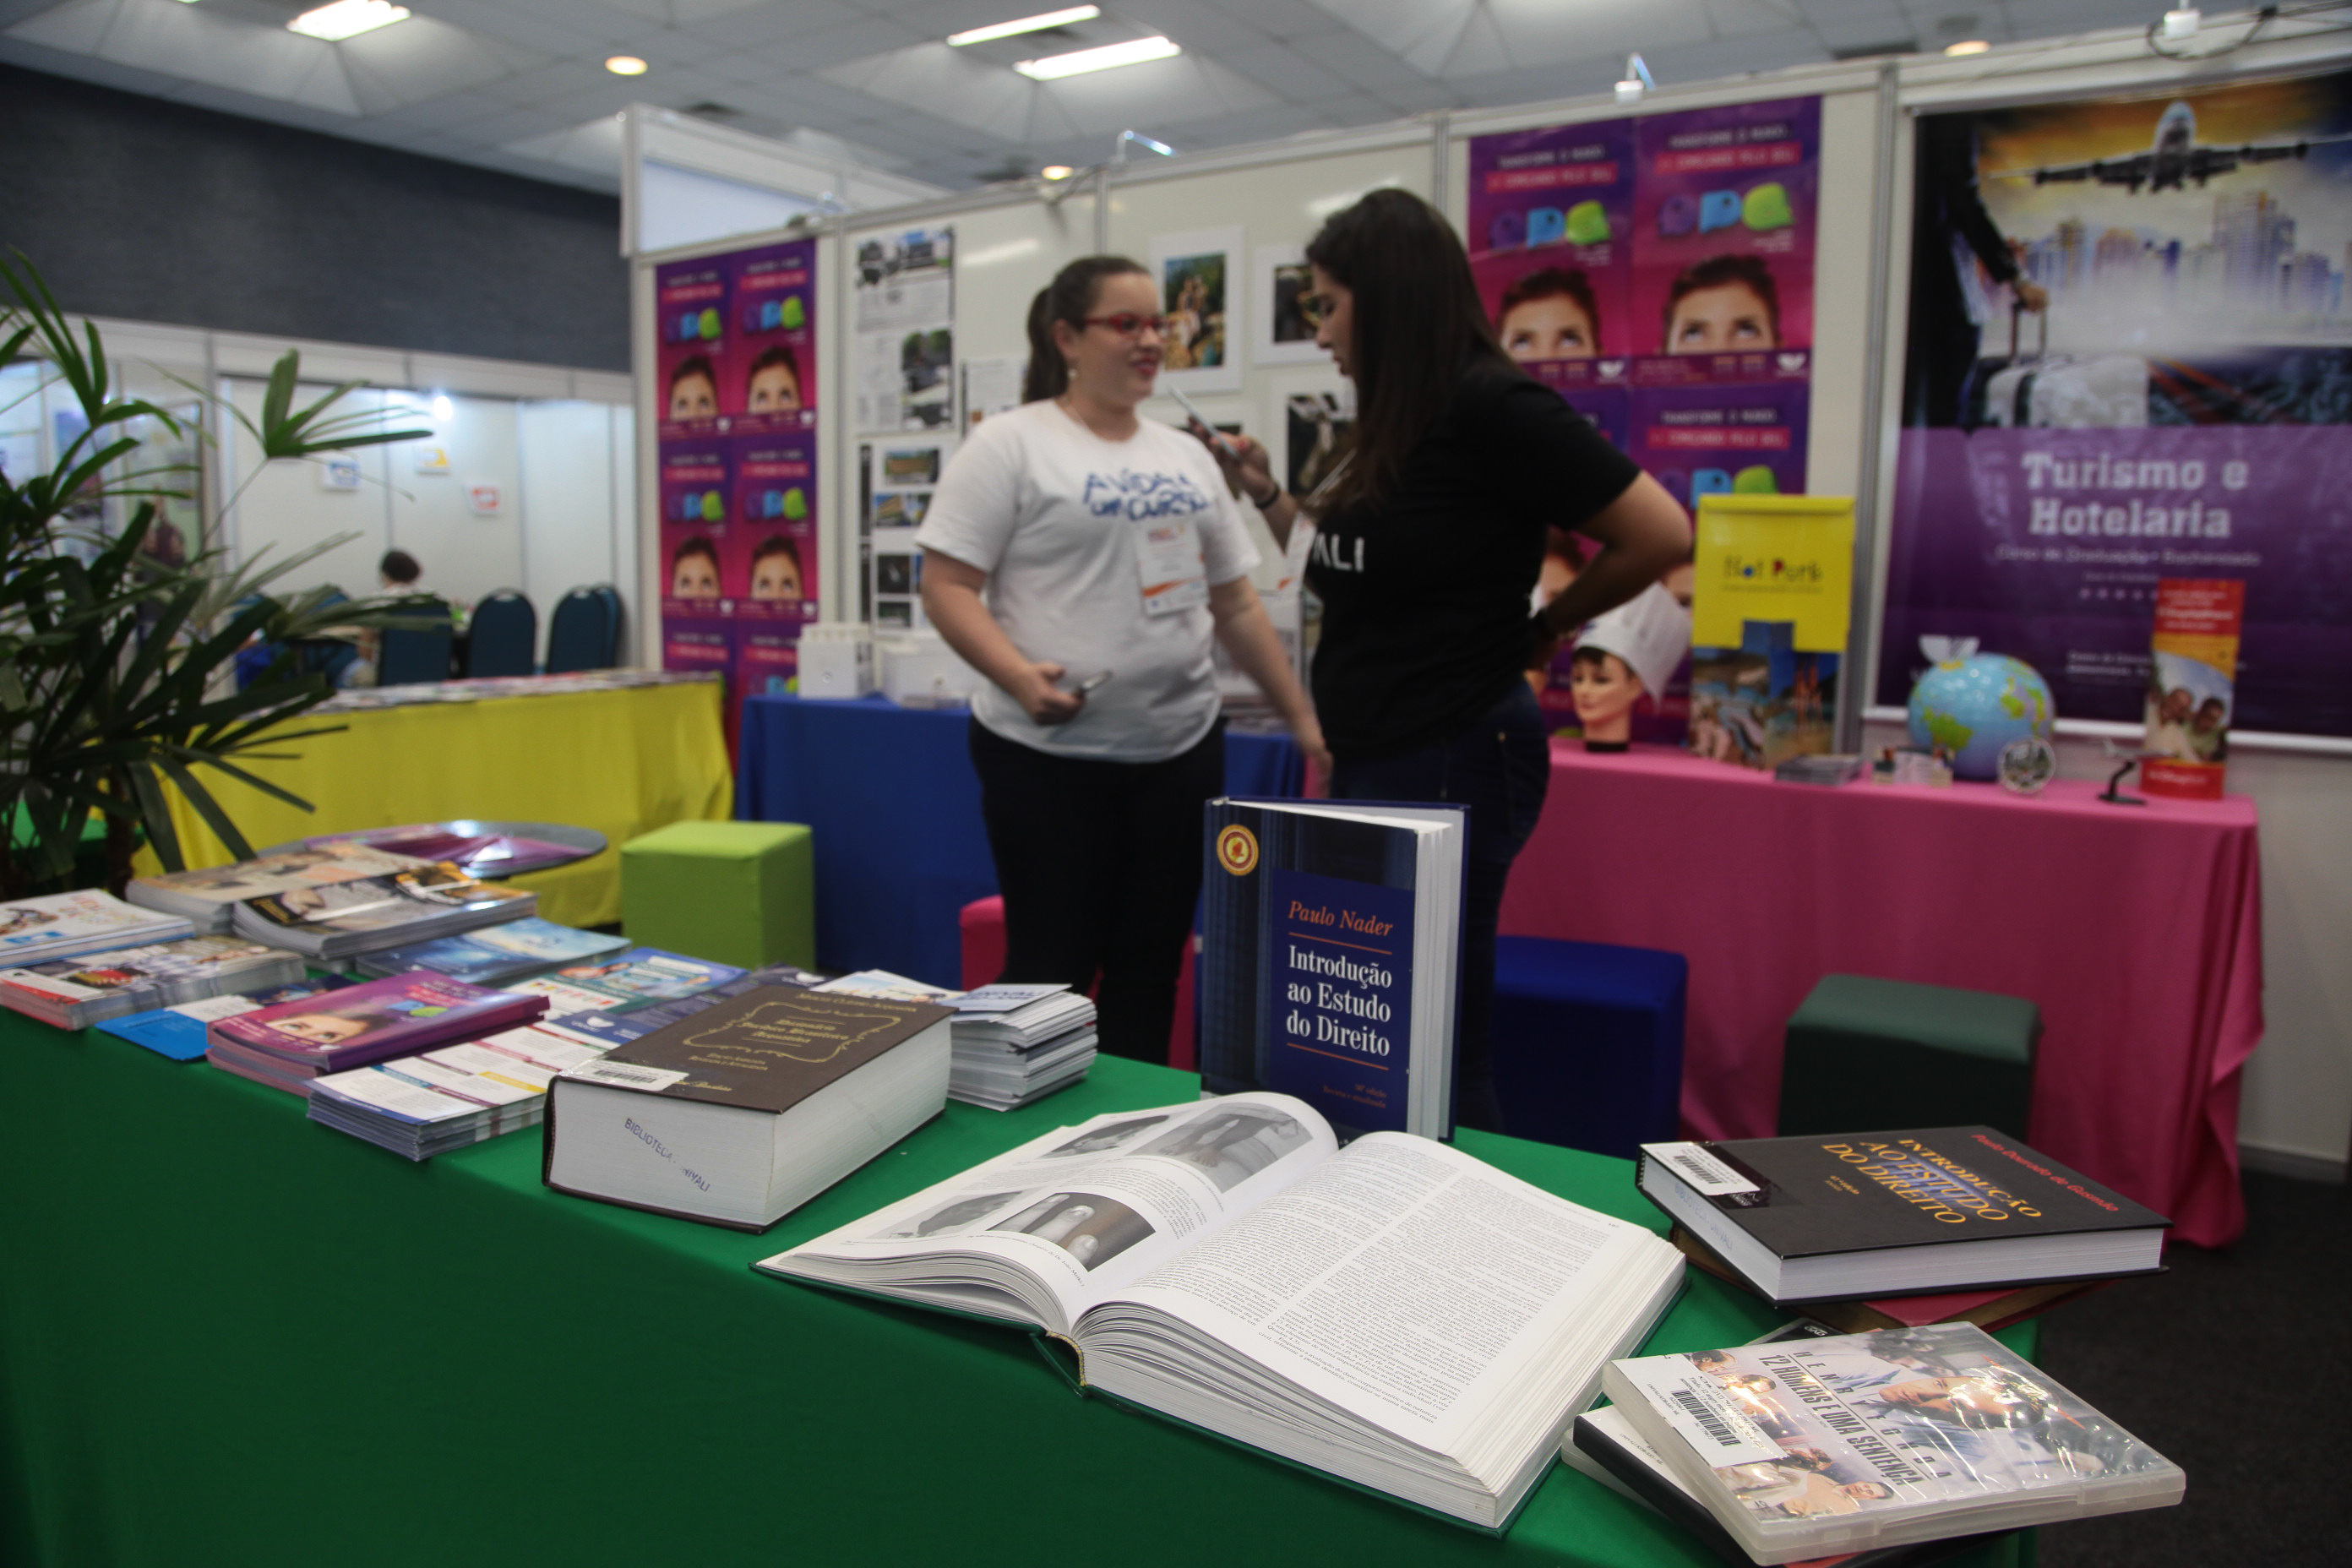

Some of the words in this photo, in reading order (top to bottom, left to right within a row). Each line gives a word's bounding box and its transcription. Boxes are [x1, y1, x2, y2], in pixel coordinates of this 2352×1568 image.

[2022, 451, 2205, 490] Turismo
[2223, 460, 2248, 489] e
[2030, 498, 2231, 538] Hotelaria
[1288, 900, 1336, 928] Paulo
[1339, 910, 1394, 937] Nader
[1288, 945, 1393, 990] Introdução
[1287, 981, 1312, 1004] ao
[1317, 982, 1391, 1023] Estudo
[1286, 1010, 1311, 1037] do
[1316, 1014, 1391, 1058] Direito
[624, 1118, 674, 1161] BIBLIOTECA
[1971, 1135, 2004, 1152] Paulo
[1821, 1144, 1869, 1163] DO
[1856, 1165, 1967, 1223] DIREITO
[1859, 1142, 1907, 1161] AO
[1897, 1163, 2009, 1221] ESTUDO
[1897, 1140, 2042, 1217] INTRODUÇÃO
[1266, 1324, 1288, 1337] Quadro
[1257, 1331, 1273, 1341] civil,
[1273, 1339, 1298, 1354] referente
[1304, 1355, 1321, 1367] perda
[1320, 1364, 1348, 1380] dentária,
[1348, 1379, 1382, 1397] constitui-se
[1383, 1396, 1398, 1406] numa
[1401, 1404, 1418, 1415] tarefa
[1419, 1413, 1435, 1423] mais
[1277, 1337, 1305, 1353] Enquanto
[1309, 1353, 1336, 1369] avaliação
[1343, 1370, 1358, 1380] dano
[1356, 1378, 1382, 1392] corporal
[1382, 1390, 1405, 1402] estético
[1413, 1404, 1438, 1419] natureza
[1286, 1329, 1312, 1344] elemento
[1402, 1388, 1432, 1404] individual
[1756, 1354, 1792, 1365] 12
[1770, 1365, 1827, 1404] HOMENS
[1792, 1351, 1870, 1407] HENRY
[1867, 1414, 1952, 1478] FONDA
[1818, 1411, 1869, 1435] UMA
[1847, 1435, 1925, 1486] SENTENÇA
